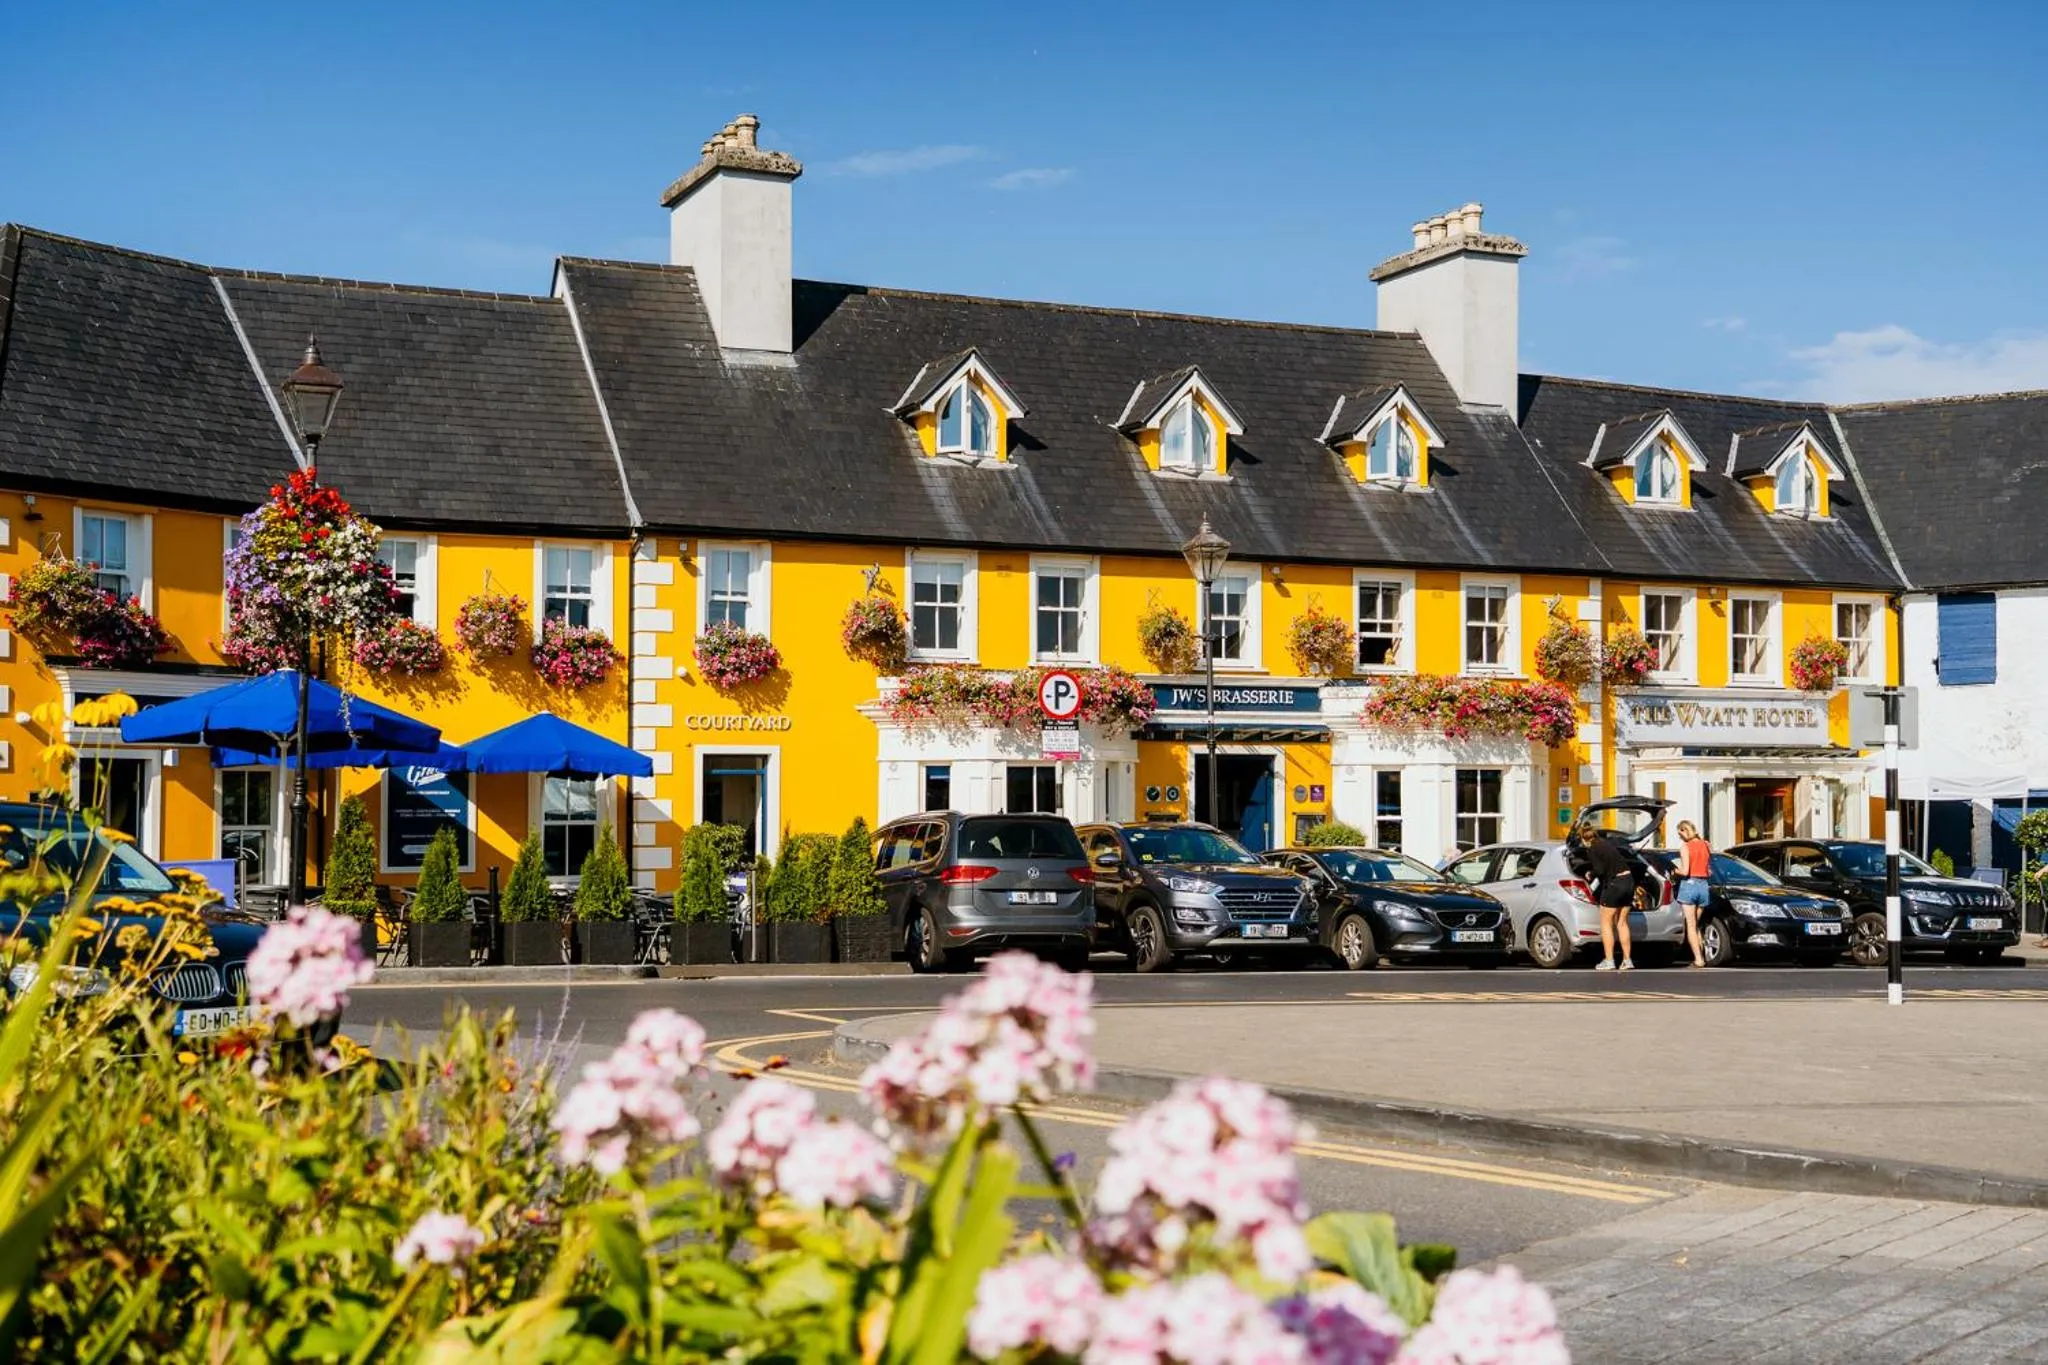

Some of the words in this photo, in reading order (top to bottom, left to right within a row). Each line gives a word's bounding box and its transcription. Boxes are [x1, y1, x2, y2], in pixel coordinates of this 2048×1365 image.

[1054, 680, 1071, 710] P
[1171, 688, 1207, 705] JW'S
[1213, 690, 1294, 705] BRASSERIE
[686, 715, 792, 731] COURTYARD
[1674, 702, 1749, 728] WYATT
[1752, 708, 1819, 728] HOTEL
